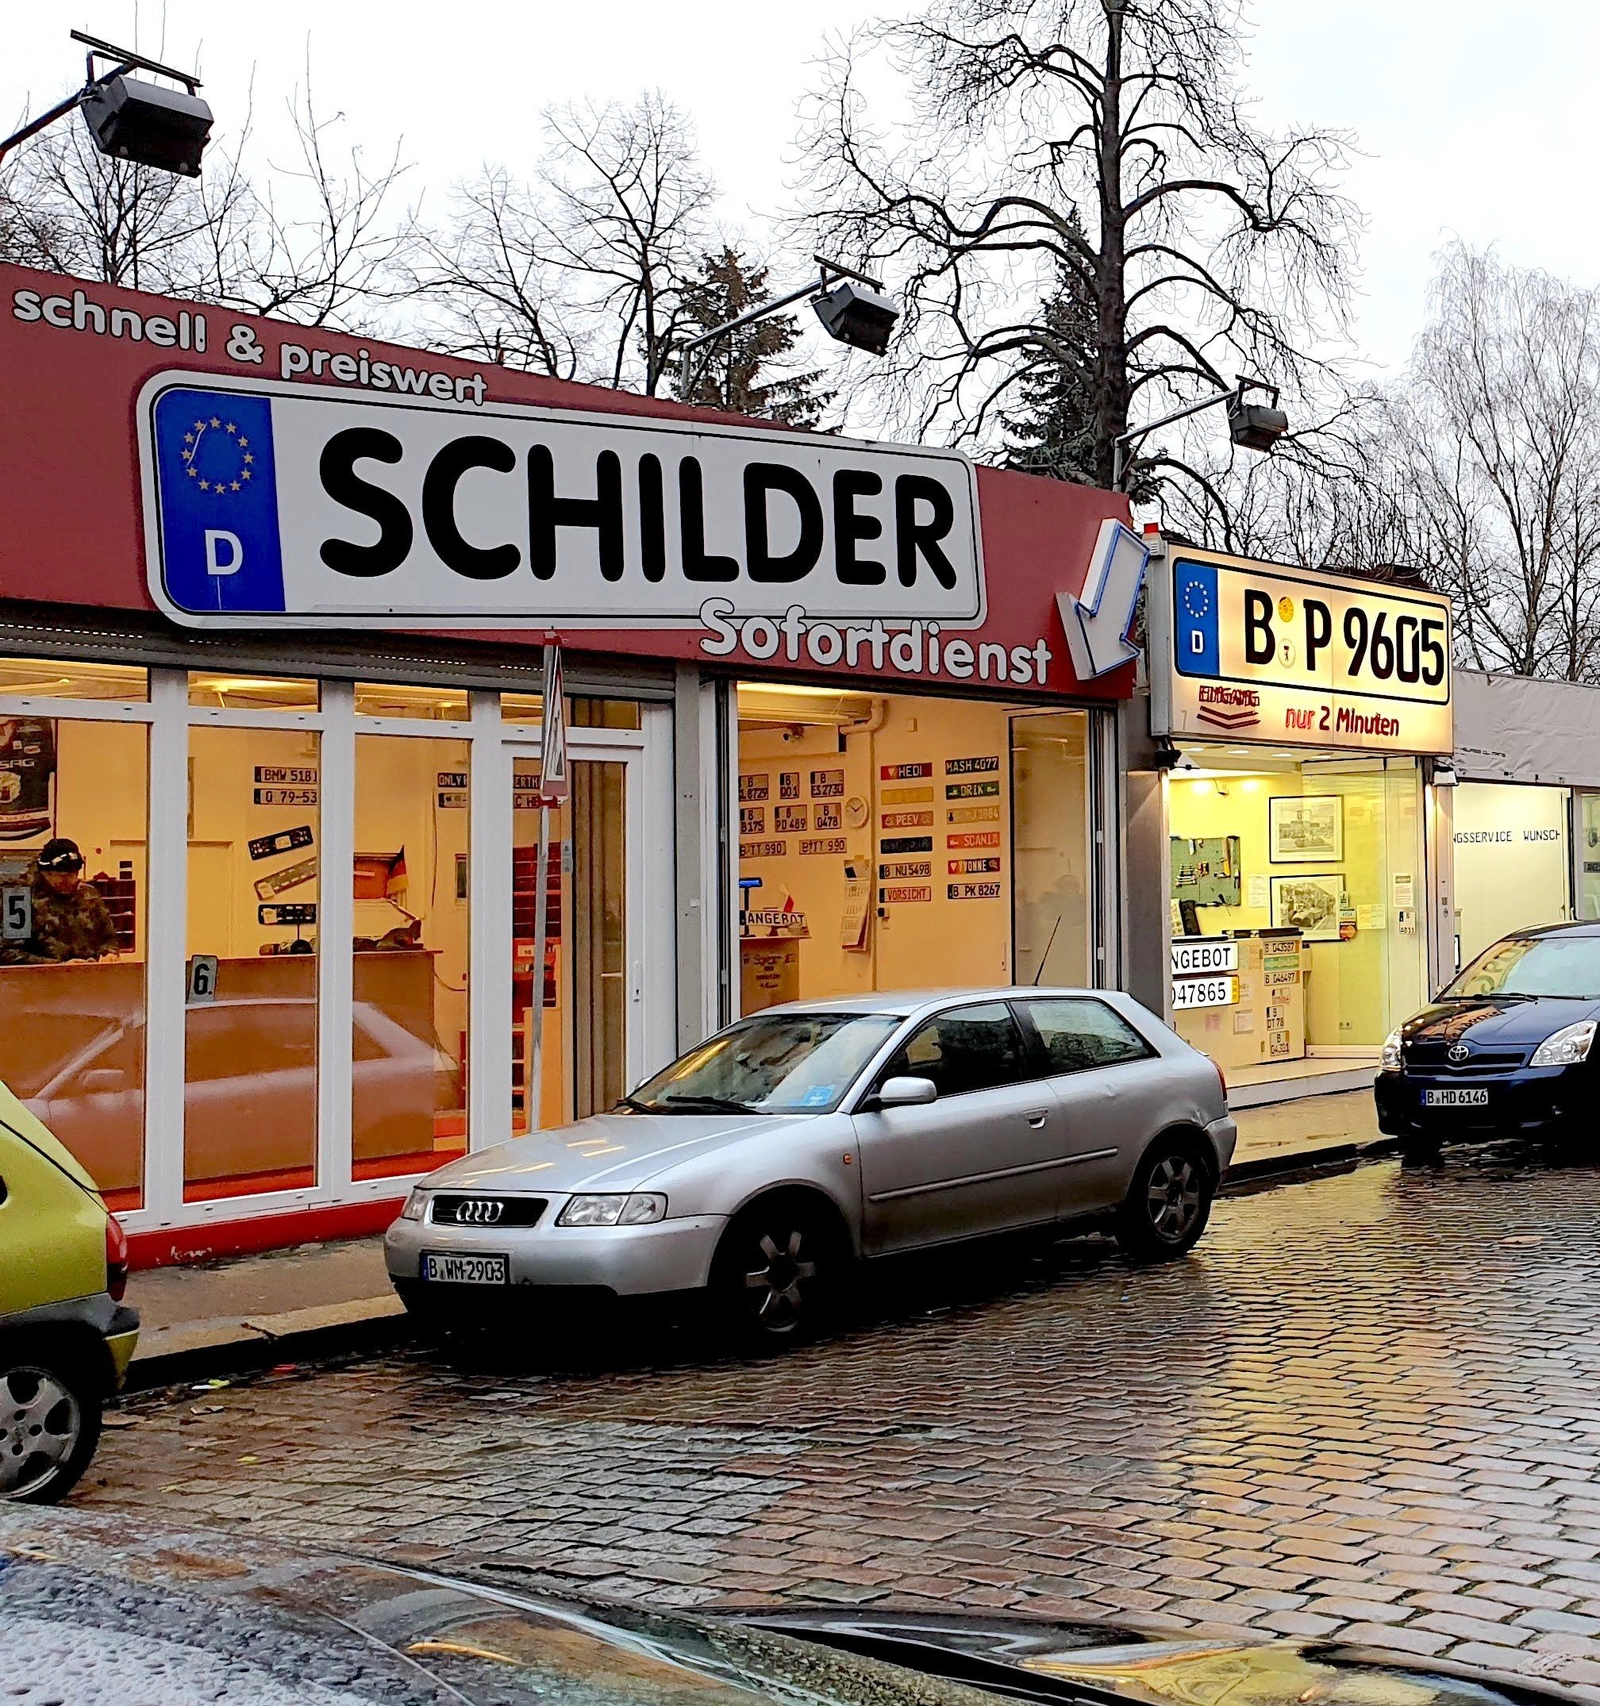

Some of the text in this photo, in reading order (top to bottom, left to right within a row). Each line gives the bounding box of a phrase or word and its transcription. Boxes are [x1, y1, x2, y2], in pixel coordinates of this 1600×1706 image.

[13, 288, 489, 406] schnell & preiswert
[319, 426, 958, 591] SCHILDER
[204, 528, 244, 576] D
[699, 596, 1053, 686] Sofortdienst
[1190, 630, 1204, 654] D
[1243, 588, 1445, 687] B P 9605
[1285, 705, 1400, 737] nur 2 Minuten
[8, 894, 27, 931] 5
[887, 888, 927, 901] VORSICHT
[1426, 1089, 1488, 1105] B HD 6146
[427, 1255, 438, 1279] B
[466, 1260, 505, 1282] 2903
